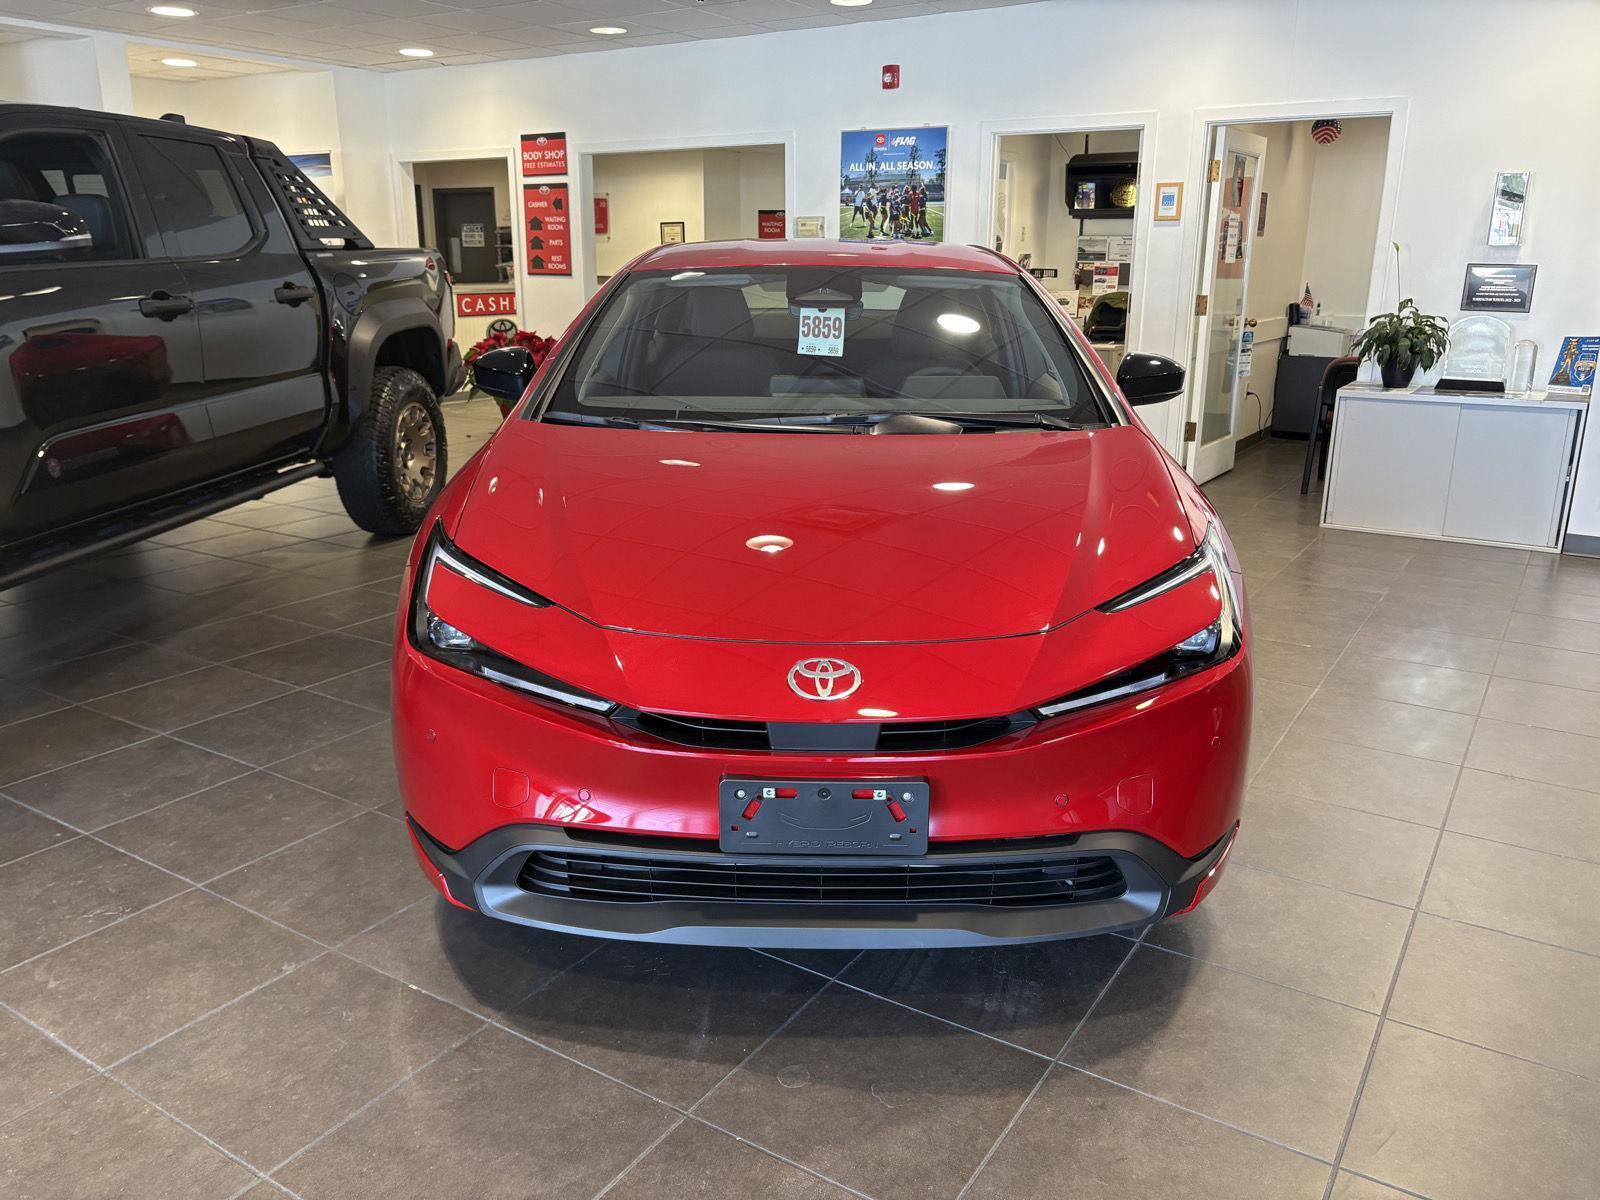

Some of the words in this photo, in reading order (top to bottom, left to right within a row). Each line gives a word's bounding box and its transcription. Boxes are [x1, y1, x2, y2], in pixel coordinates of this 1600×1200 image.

[523, 151, 542, 160] BODY
[544, 150, 565, 159] SHOP
[849, 162, 864, 171] ALL
[866, 162, 878, 170] IN.
[880, 161, 895, 170] ALL
[897, 160, 936, 170] SEASON.
[801, 315, 843, 340] 5859
